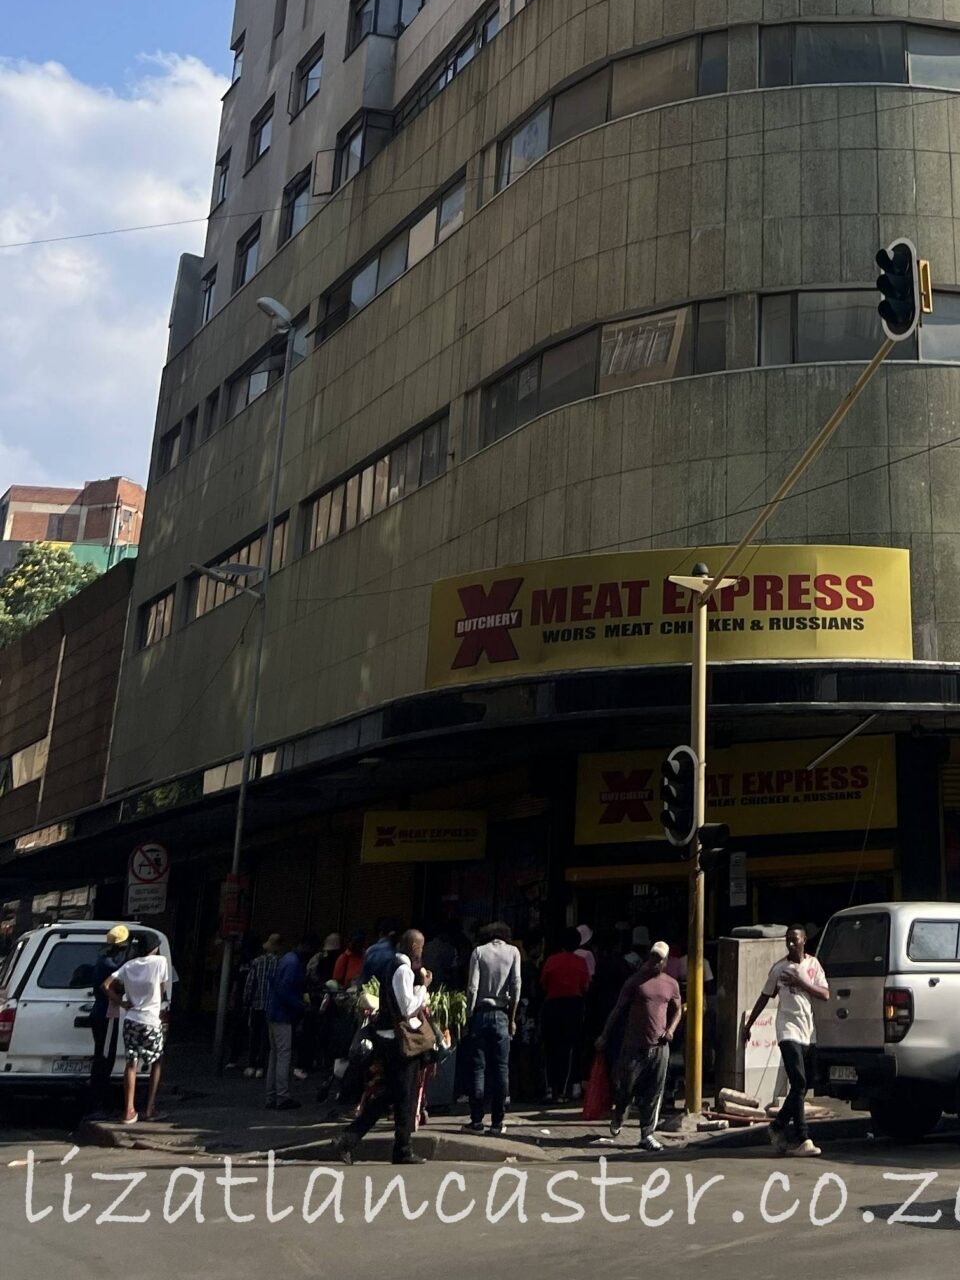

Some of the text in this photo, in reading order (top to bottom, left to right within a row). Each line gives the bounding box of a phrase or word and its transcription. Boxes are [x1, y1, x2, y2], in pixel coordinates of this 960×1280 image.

[531, 580, 650, 626] MEAT
[457, 612, 518, 634] BUTCHERY
[543, 617, 864, 644] WORS MEAT CHIKEN & RUSSIANS
[742, 765, 869, 795] EXPRESS
[741, 795, 789, 807] CHICKEN
[804, 791, 862, 802] RUSSIANS
